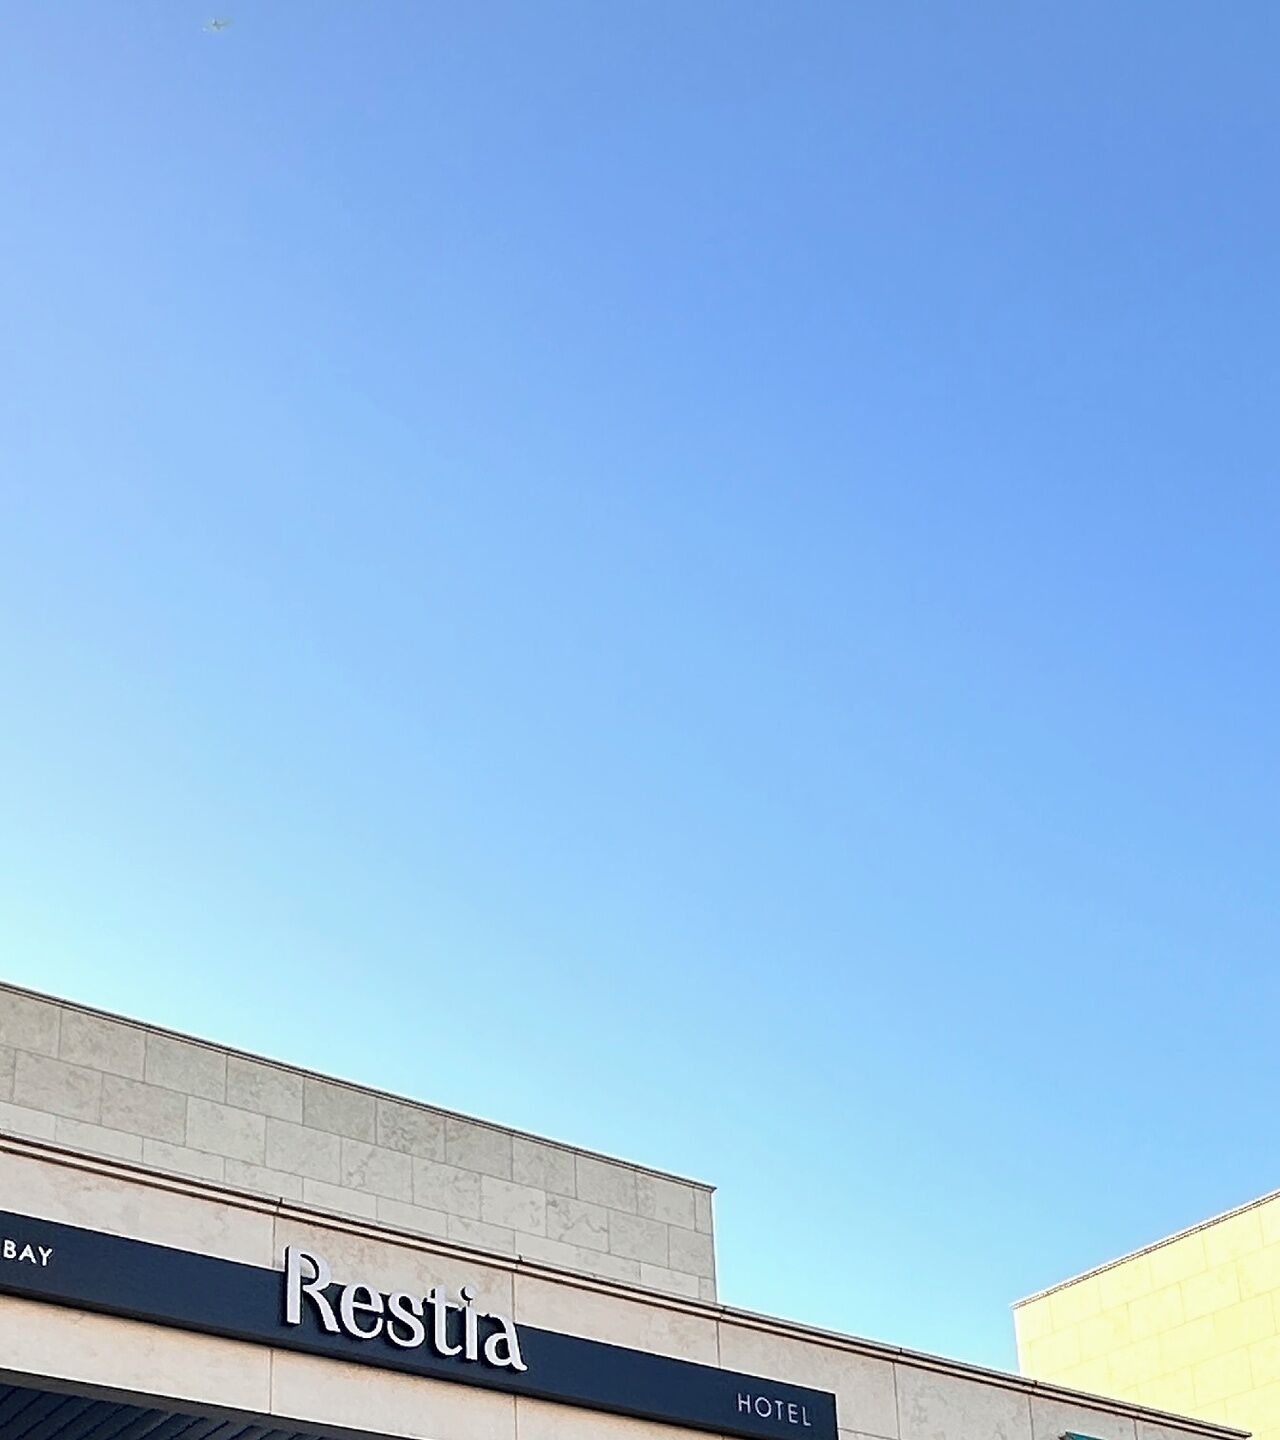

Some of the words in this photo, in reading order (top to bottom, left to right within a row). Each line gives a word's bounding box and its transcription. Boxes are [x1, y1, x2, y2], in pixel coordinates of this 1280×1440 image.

[2, 1239, 54, 1267] BAY
[285, 1246, 529, 1372] Restia
[737, 1392, 812, 1427] HOTEL
